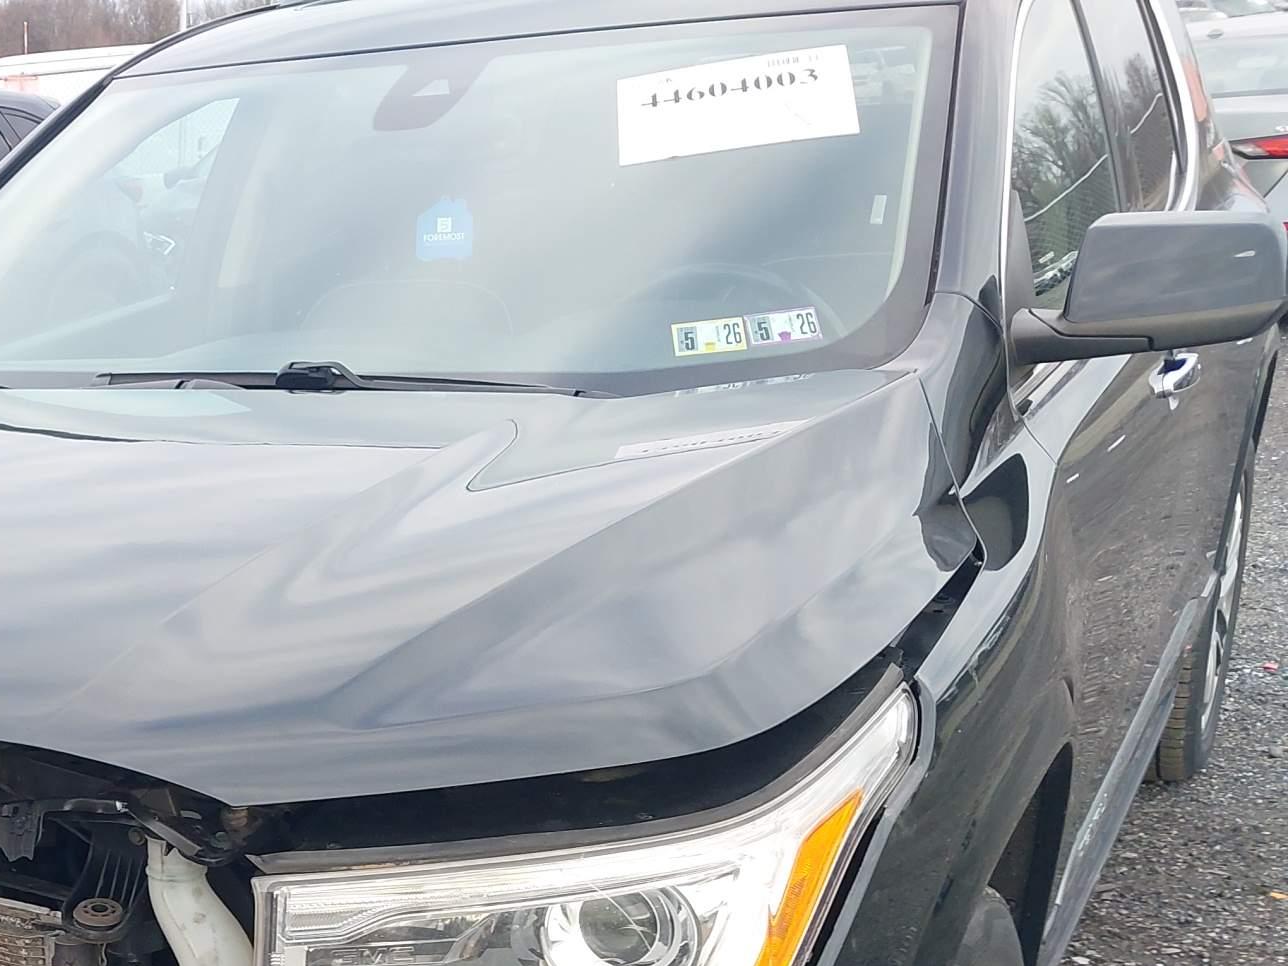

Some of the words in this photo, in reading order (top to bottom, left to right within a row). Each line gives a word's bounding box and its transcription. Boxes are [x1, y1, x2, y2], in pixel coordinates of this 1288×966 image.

[641, 68, 818, 107] 44604003
[683, 331, 695, 351] 5
[723, 322, 742, 345] 26
[757, 321, 770, 341] 5
[796, 312, 817, 335] 26
